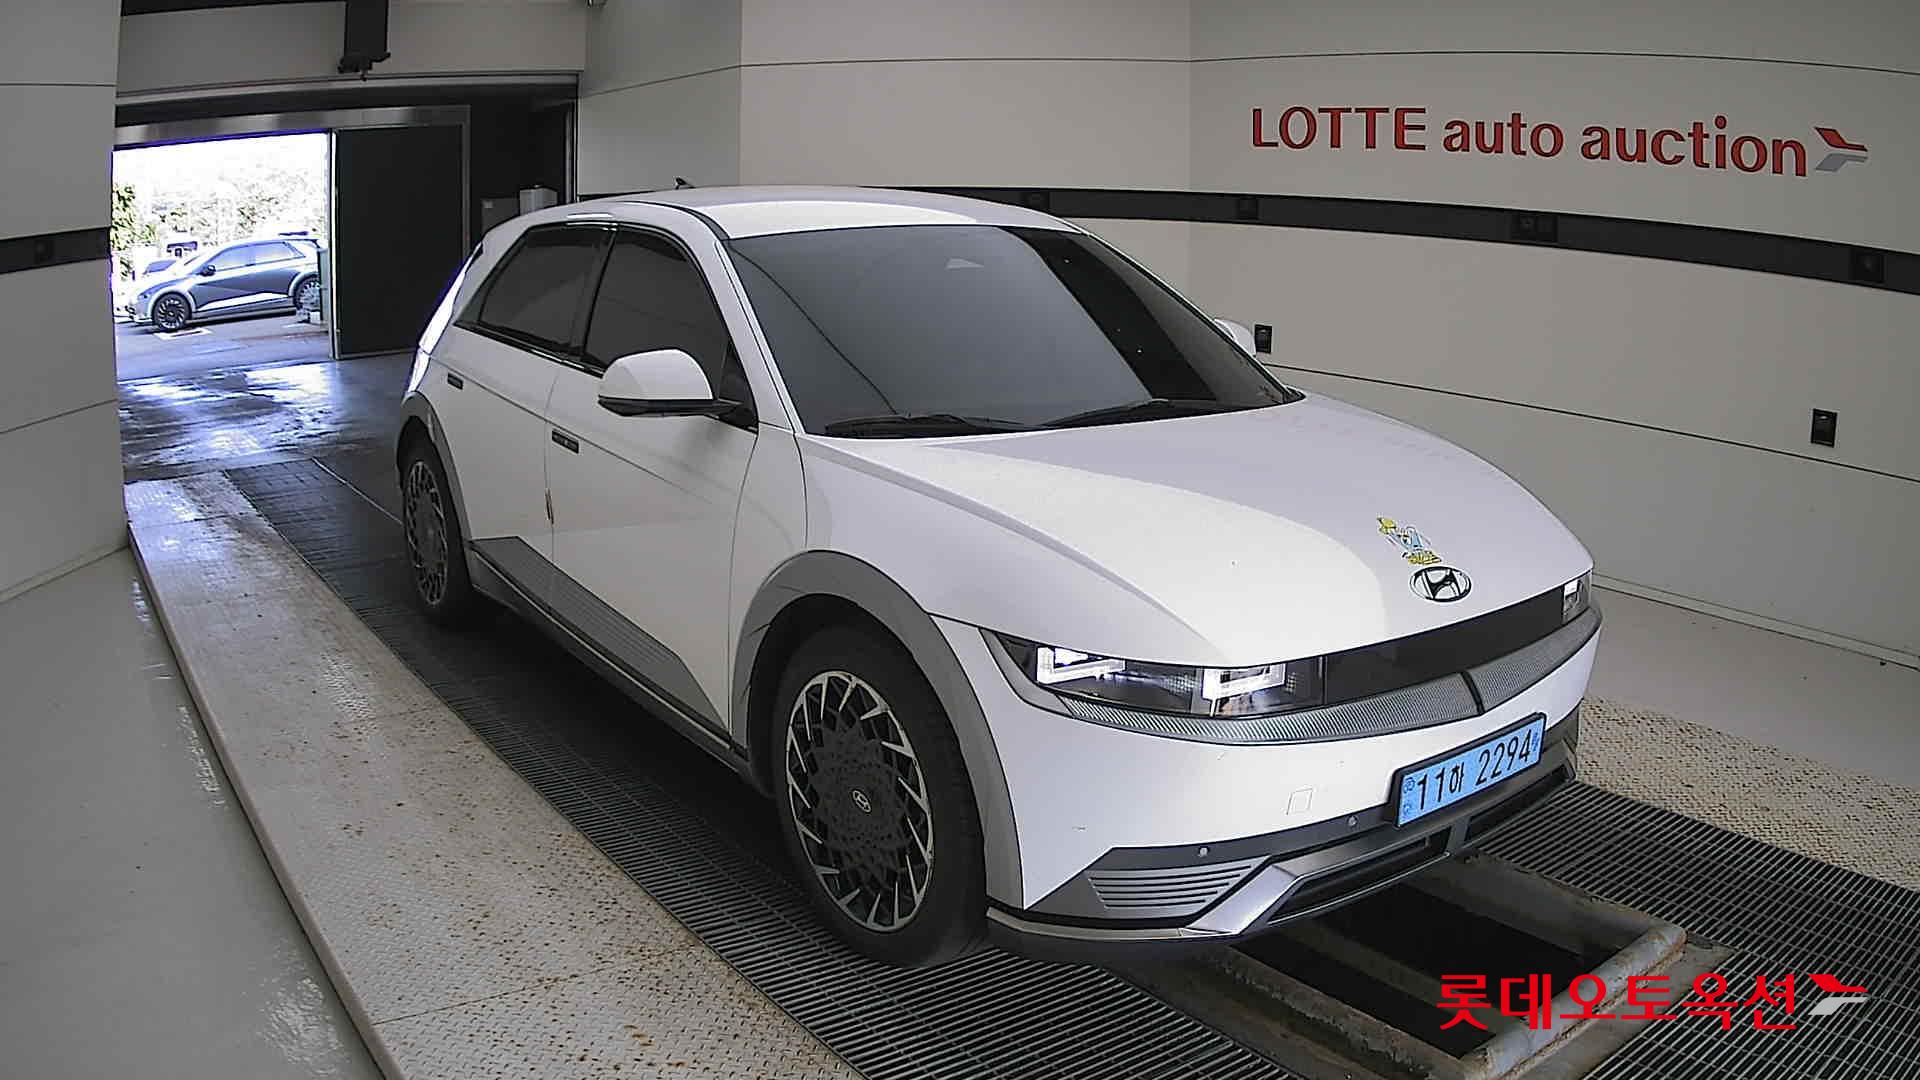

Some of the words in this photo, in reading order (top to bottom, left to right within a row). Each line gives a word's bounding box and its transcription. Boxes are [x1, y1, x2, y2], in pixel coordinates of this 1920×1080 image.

[1252, 106, 1427, 151] LOTTE
[1443, 113, 1564, 158] auto
[1580, 115, 1808, 178] auction
[1417, 762, 1465, 810] 11하
[1475, 729, 1532, 786] 2294
